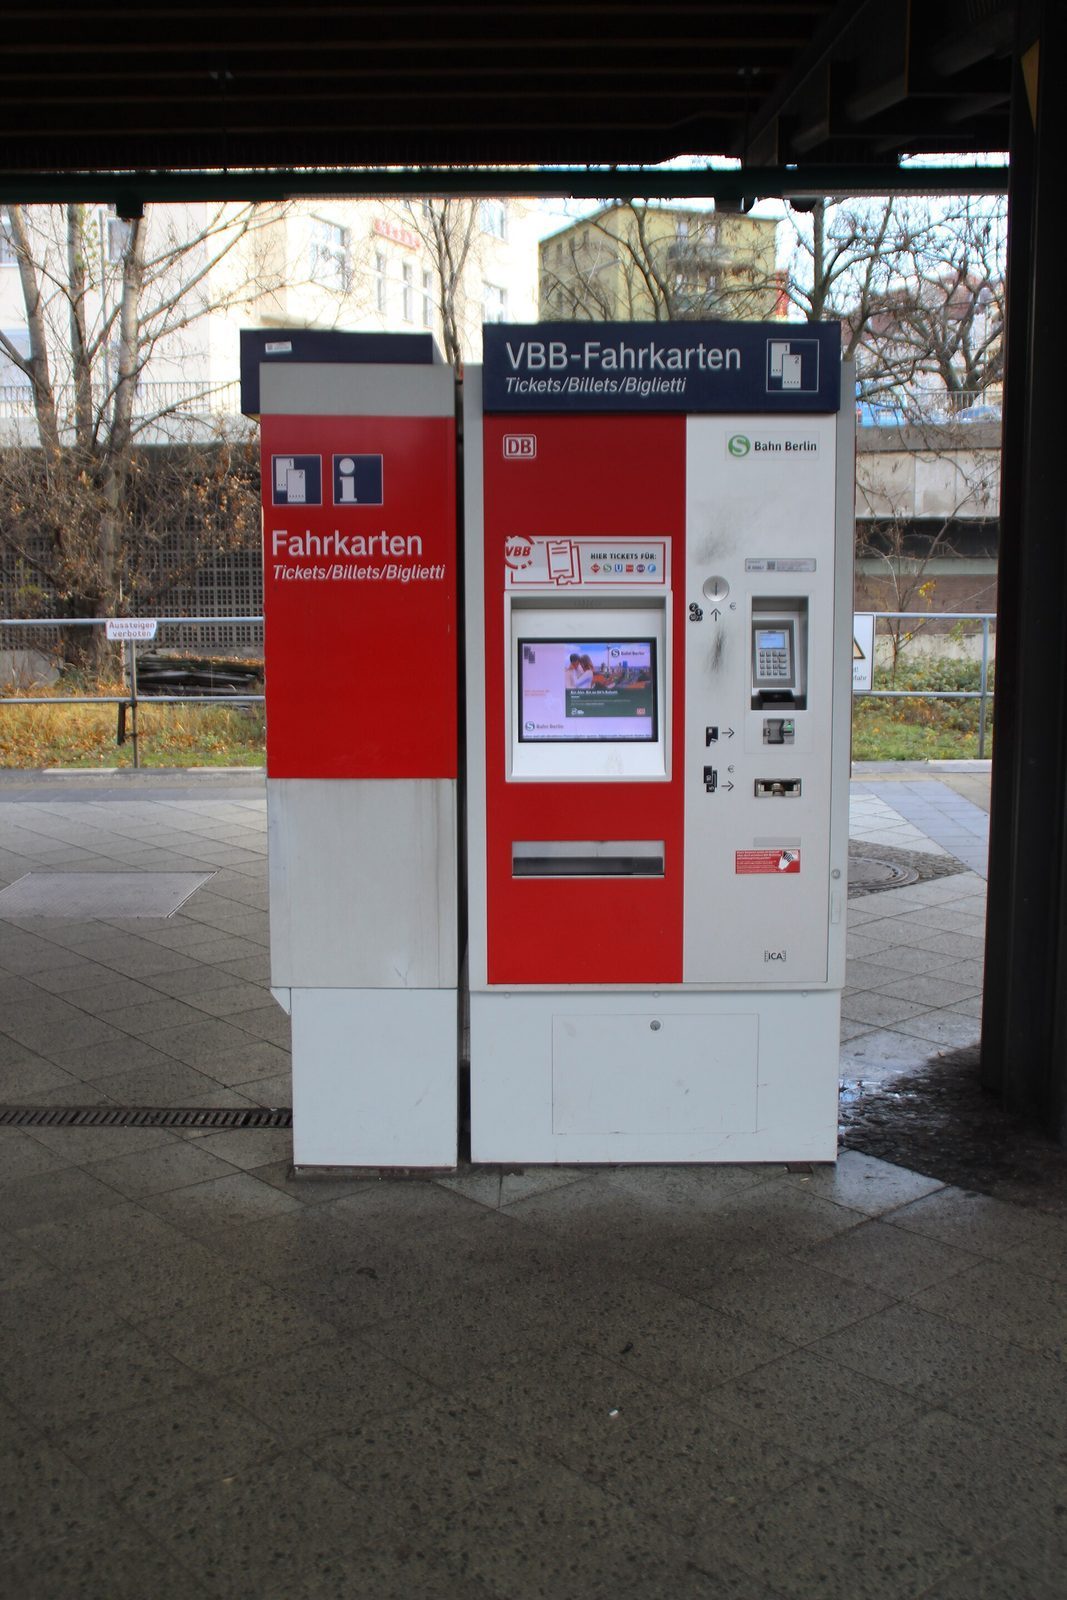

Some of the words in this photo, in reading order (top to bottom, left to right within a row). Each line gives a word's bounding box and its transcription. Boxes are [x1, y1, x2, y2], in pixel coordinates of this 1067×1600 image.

[506, 342, 742, 370] VBB-Fahrkarten
[505, 376, 686, 397] Tickets/Billets/Biglietti
[508, 438, 533, 456] DB
[754, 440, 783, 452] Bahn
[785, 440, 818, 452] Berlin
[272, 530, 423, 556] Fahrkarten
[505, 546, 532, 557] VBB
[590, 552, 608, 560] HIER
[610, 552, 639, 560] TICKETS
[273, 564, 446, 582] Tickets/Billets/Biglietti
[109, 621, 155, 630] Aussteigen
[768, 952, 783, 960] ICA
